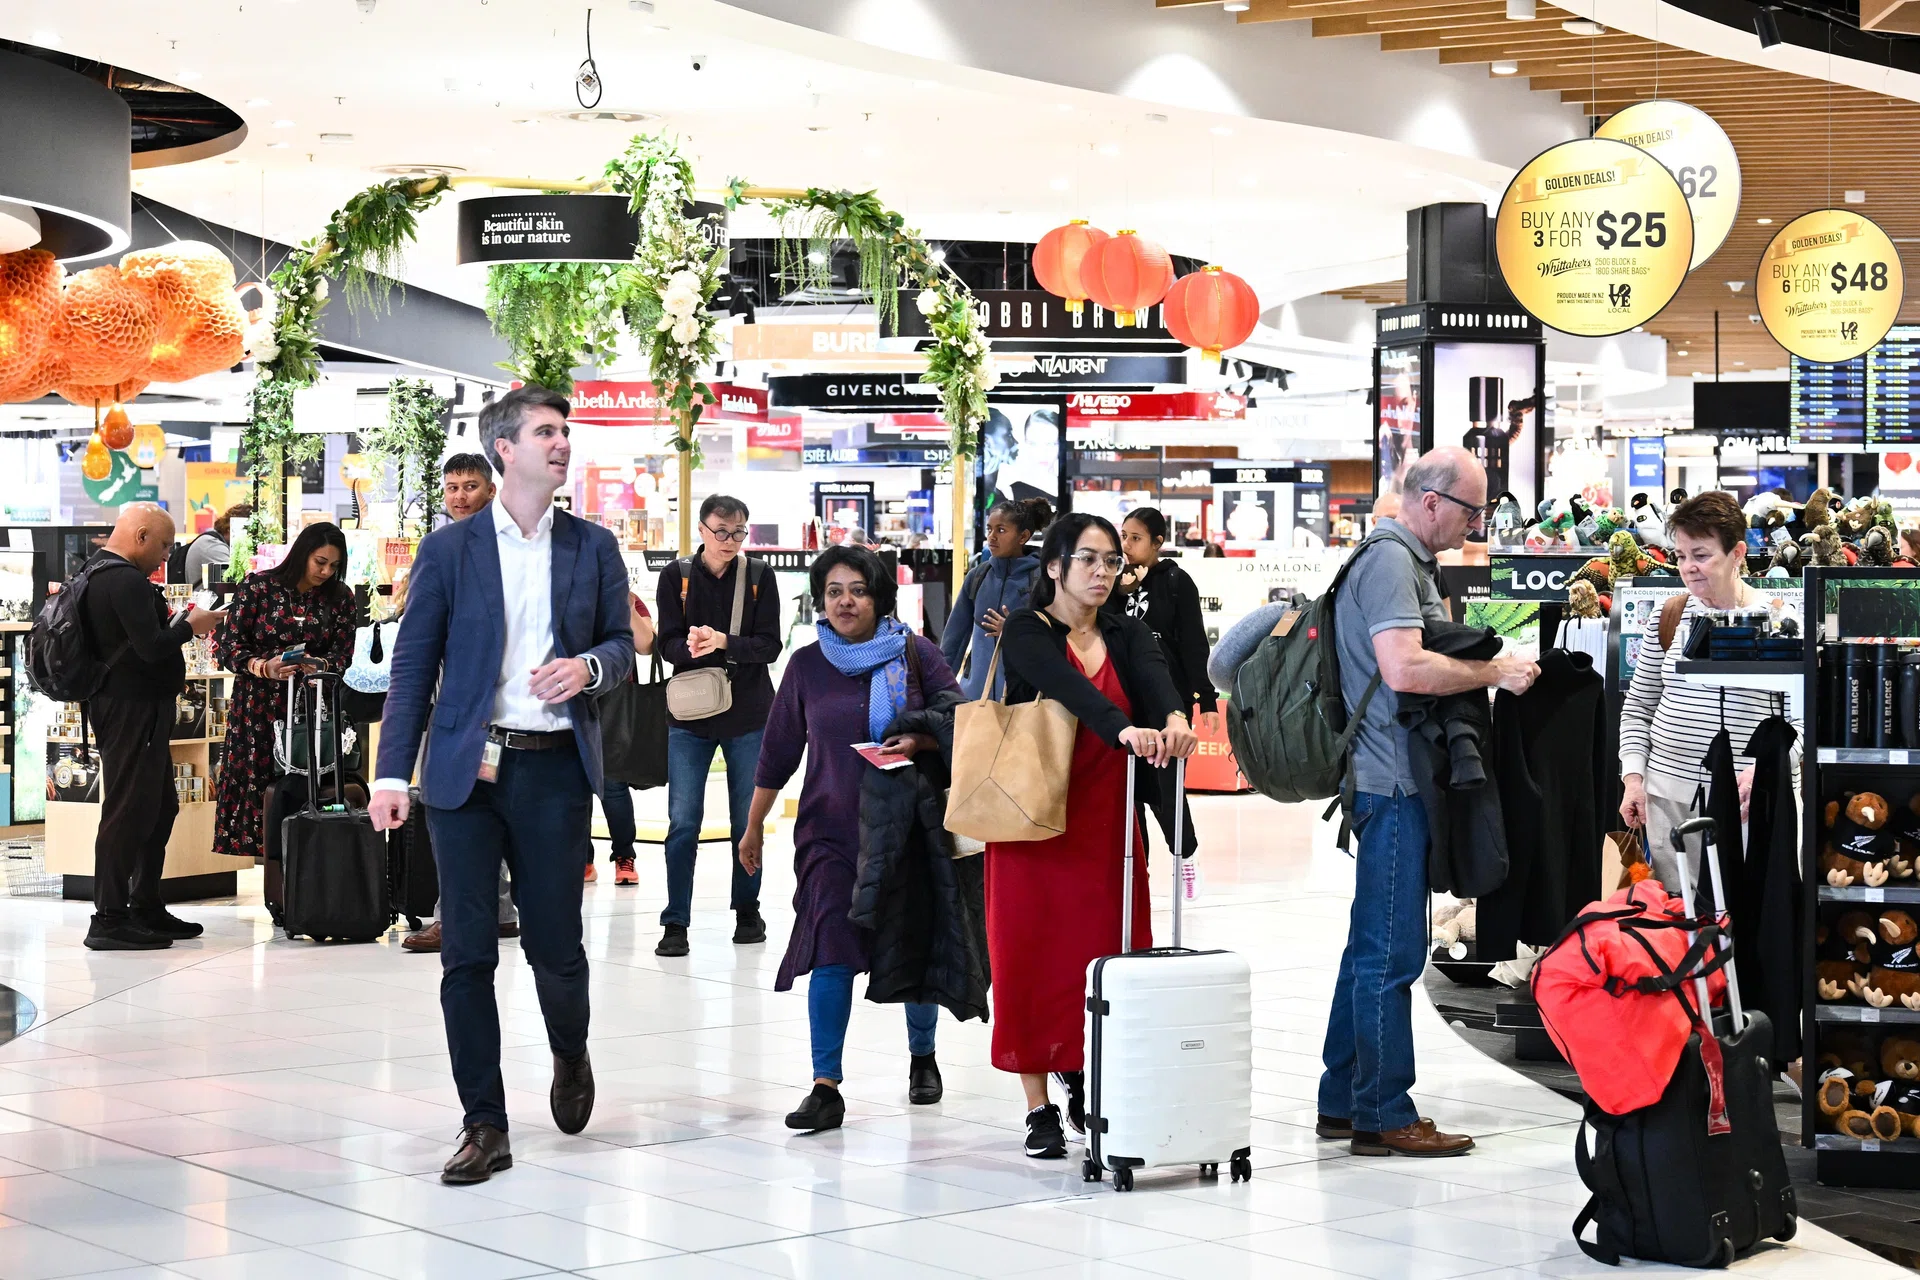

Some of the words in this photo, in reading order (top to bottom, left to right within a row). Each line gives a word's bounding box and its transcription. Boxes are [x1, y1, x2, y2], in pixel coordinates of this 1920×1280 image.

[1645, 129, 1674, 145] DEALS!
[1544, 173, 1582, 191] GOLDEN
[1583, 170, 1616, 186] DEALS!
[1665, 164, 1718, 199] 62
[484, 217, 533, 233] Beautiful
[536, 217, 564, 231] skin
[1521, 211, 1555, 229] BUY
[1560, 211, 1594, 229] ANY
[481, 232, 490, 245] is
[491, 231, 501, 245] in
[503, 234, 525, 244] our
[527, 232, 571, 243] nature
[1533, 231, 1544, 248] 3
[1549, 230, 1582, 247] FOR
[1596, 209, 1667, 251] $25
[1791, 237, 1818, 250] GOLDEN
[1819, 232, 1843, 246] DEALS!
[1595, 257, 1611, 266] 250G
[1611, 257, 1631, 266] BLOCK
[1610, 267, 1631, 275] SHARE
[1772, 264, 1799, 279] BUY
[1802, 263, 1830, 278] ANY
[1830, 261, 1888, 294] $48
[1782, 279, 1791, 293] 6
[1794, 278, 1820, 293] FOR
[979, 301, 1048, 328] OBBI
[1236, 563, 1255, 573] JO
[1259, 563, 1322, 573] MALONE
[1851, 679, 1859, 716] BLACKS
[1884, 680, 1892, 717] BLACKS
[1851, 716, 1859, 734] ALL
[1884, 718, 1892, 735] ALL
[1191, 741, 1230, 757] EEK
